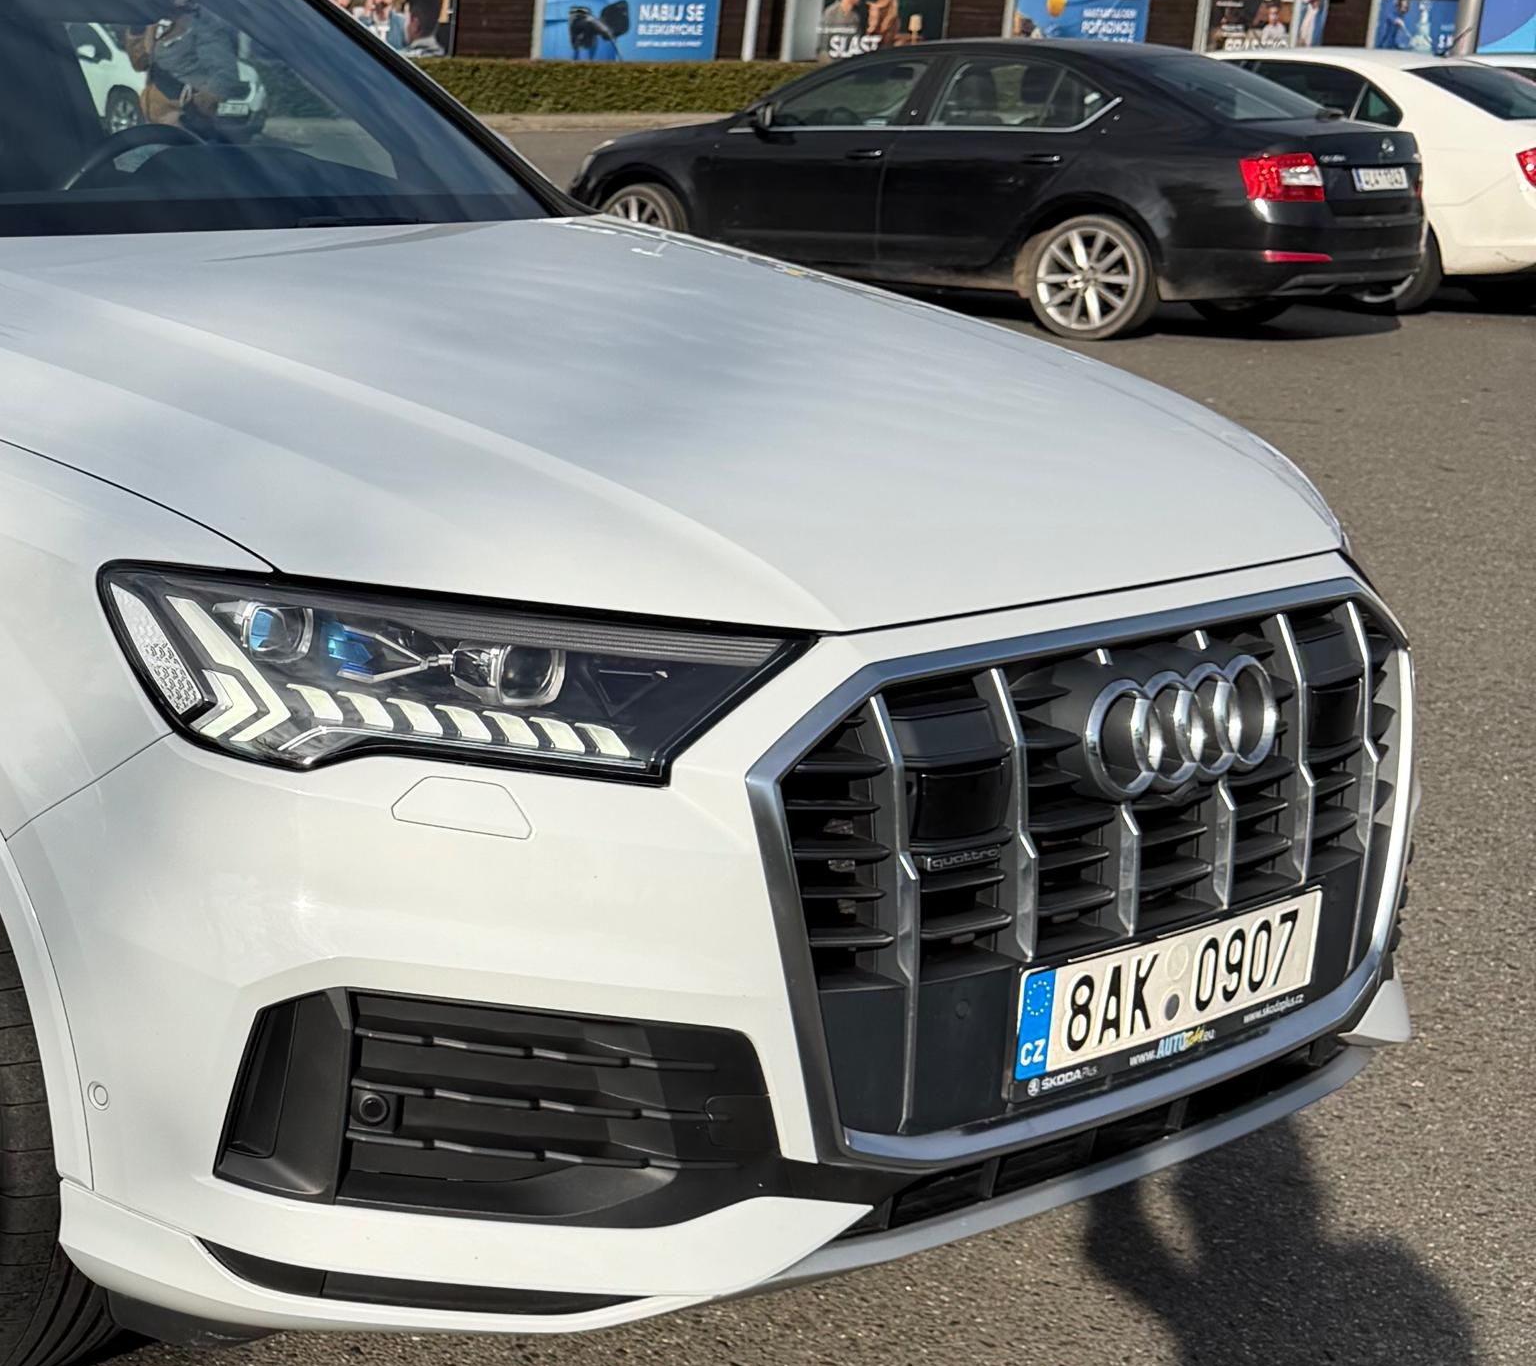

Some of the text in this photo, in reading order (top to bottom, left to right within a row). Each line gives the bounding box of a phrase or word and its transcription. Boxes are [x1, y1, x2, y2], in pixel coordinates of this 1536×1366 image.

[686, 3, 706, 22] SE
[931, 848, 999, 867] quattro
[1066, 908, 1299, 1052] 8AK 0907
[1020, 1038, 1046, 1066] CZ
